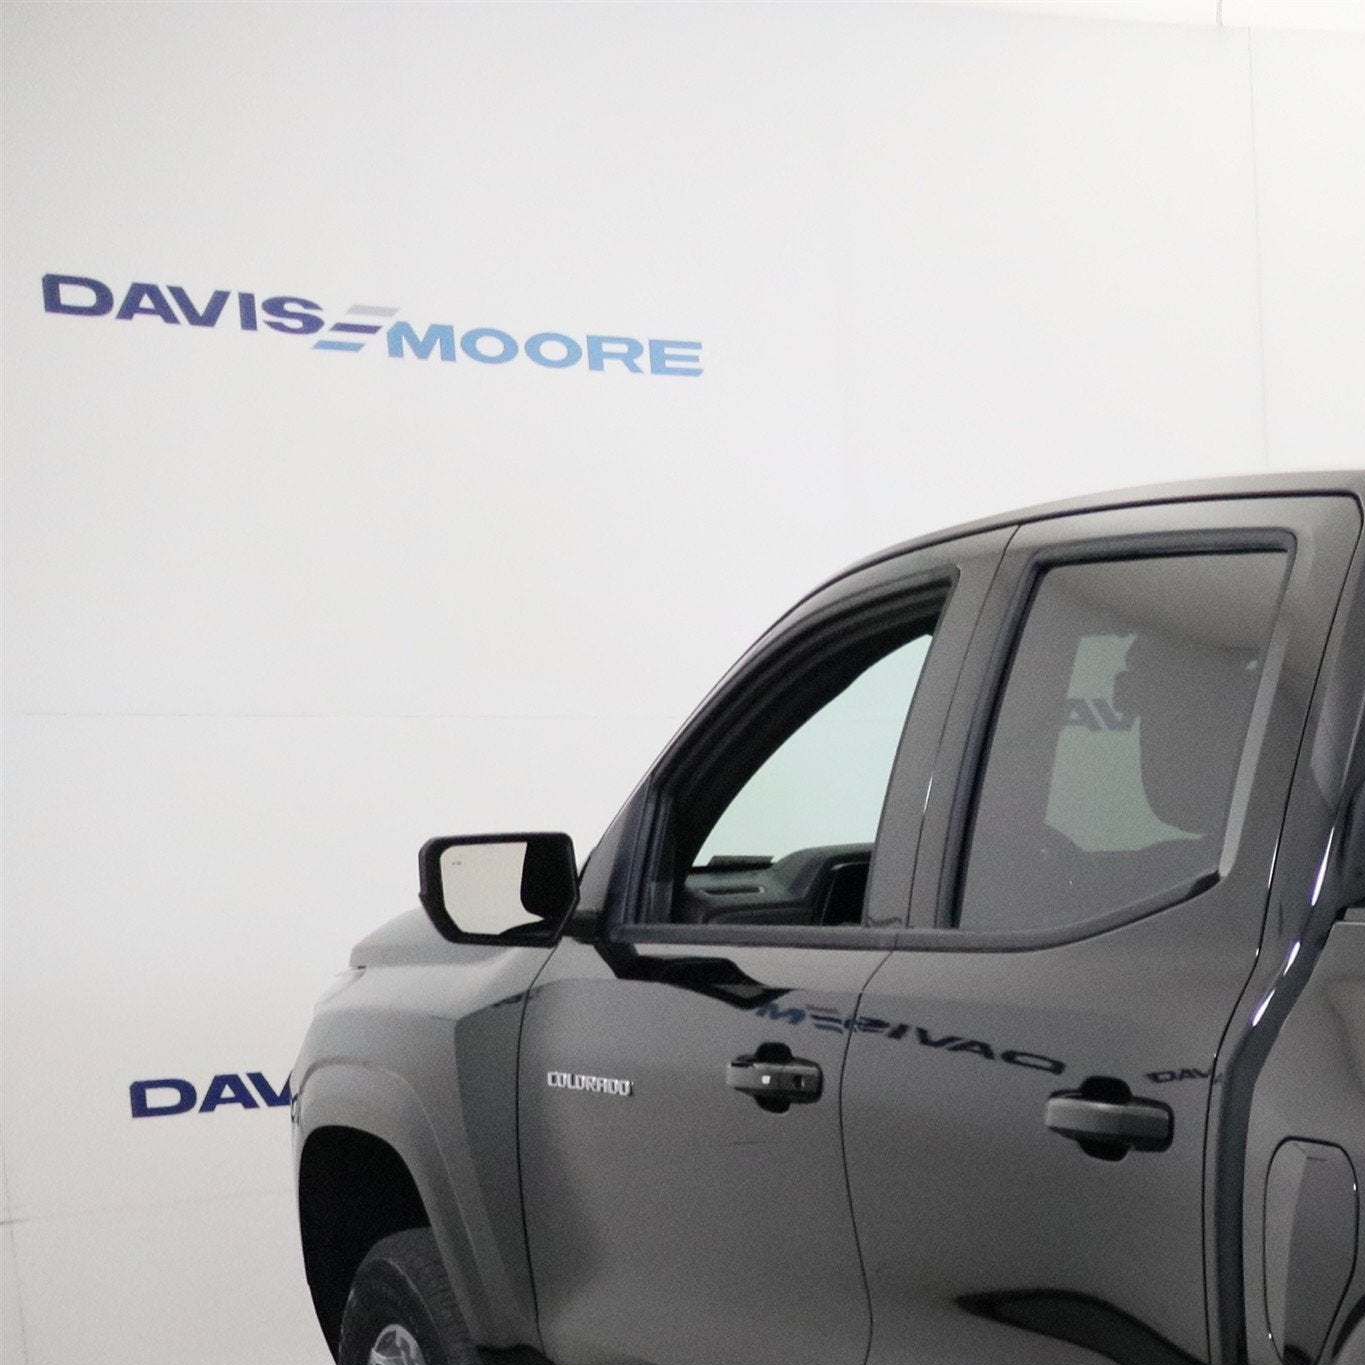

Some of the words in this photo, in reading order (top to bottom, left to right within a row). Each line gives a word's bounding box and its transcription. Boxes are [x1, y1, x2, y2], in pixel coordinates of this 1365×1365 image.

[42, 272, 326, 336] DAVIS
[385, 320, 705, 379] MOORE
[129, 1072, 293, 1119] DAV
[547, 1070, 632, 1097] COLORADO
